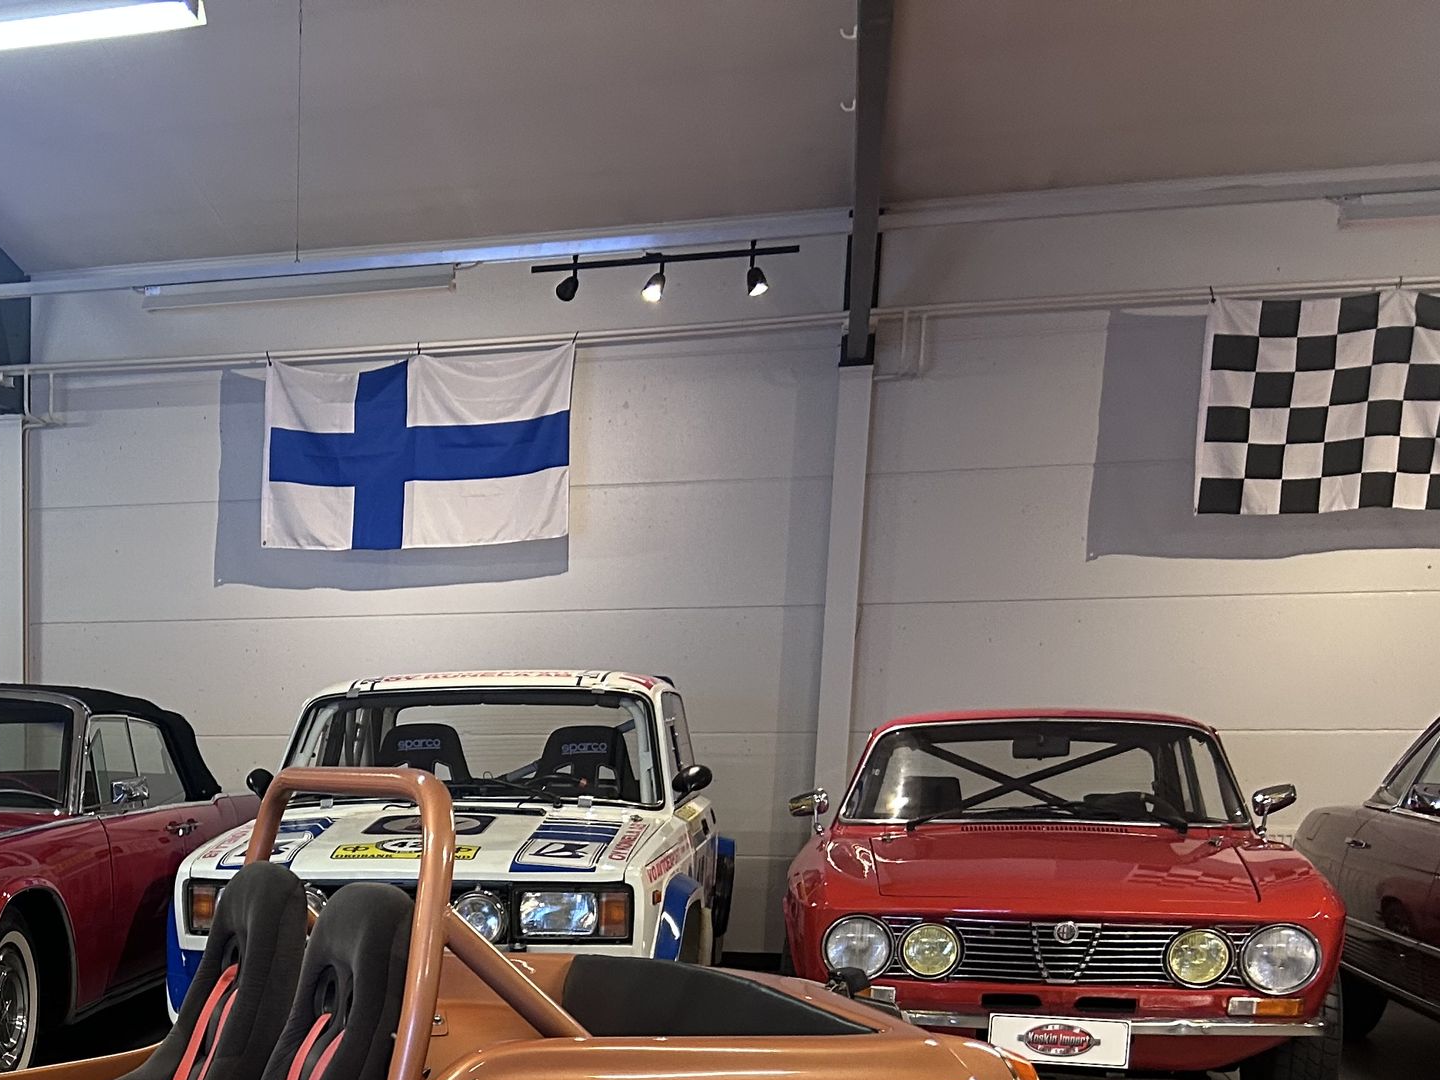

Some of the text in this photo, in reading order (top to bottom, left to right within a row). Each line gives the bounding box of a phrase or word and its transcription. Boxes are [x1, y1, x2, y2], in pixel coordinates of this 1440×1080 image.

[397, 738, 441, 751] sparco
[561, 743, 607, 756] sparco
[1060, 1033, 1090, 1047] Import
